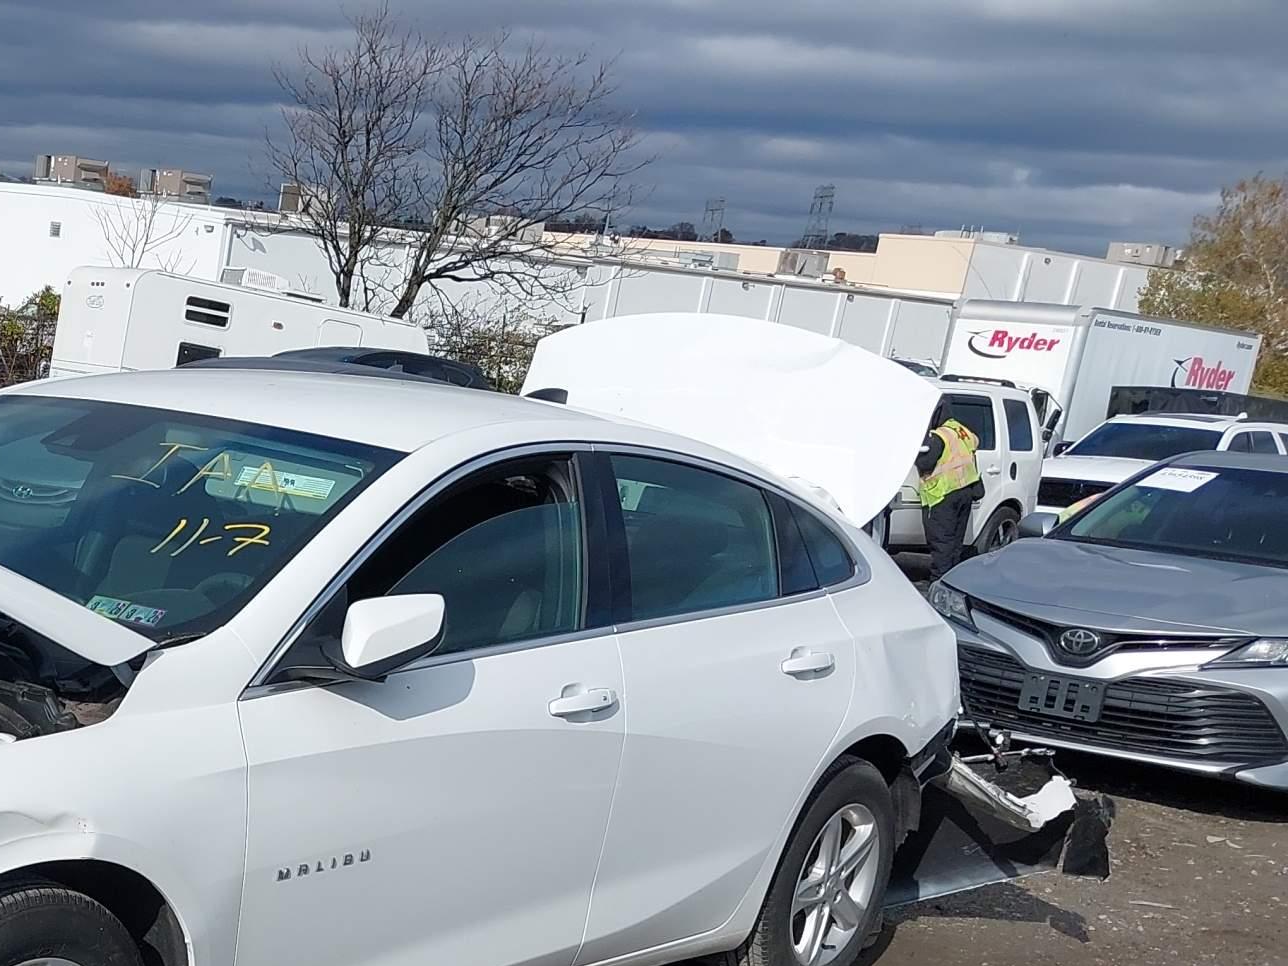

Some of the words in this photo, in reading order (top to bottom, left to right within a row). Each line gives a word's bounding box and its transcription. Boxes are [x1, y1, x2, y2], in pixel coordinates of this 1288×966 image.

[988, 330, 1061, 353] Ryder
[1185, 357, 1235, 390] Ryder
[111, 442, 280, 516] IAA
[150, 517, 272, 557] 11-7
[276, 848, 372, 881] MALIBU
